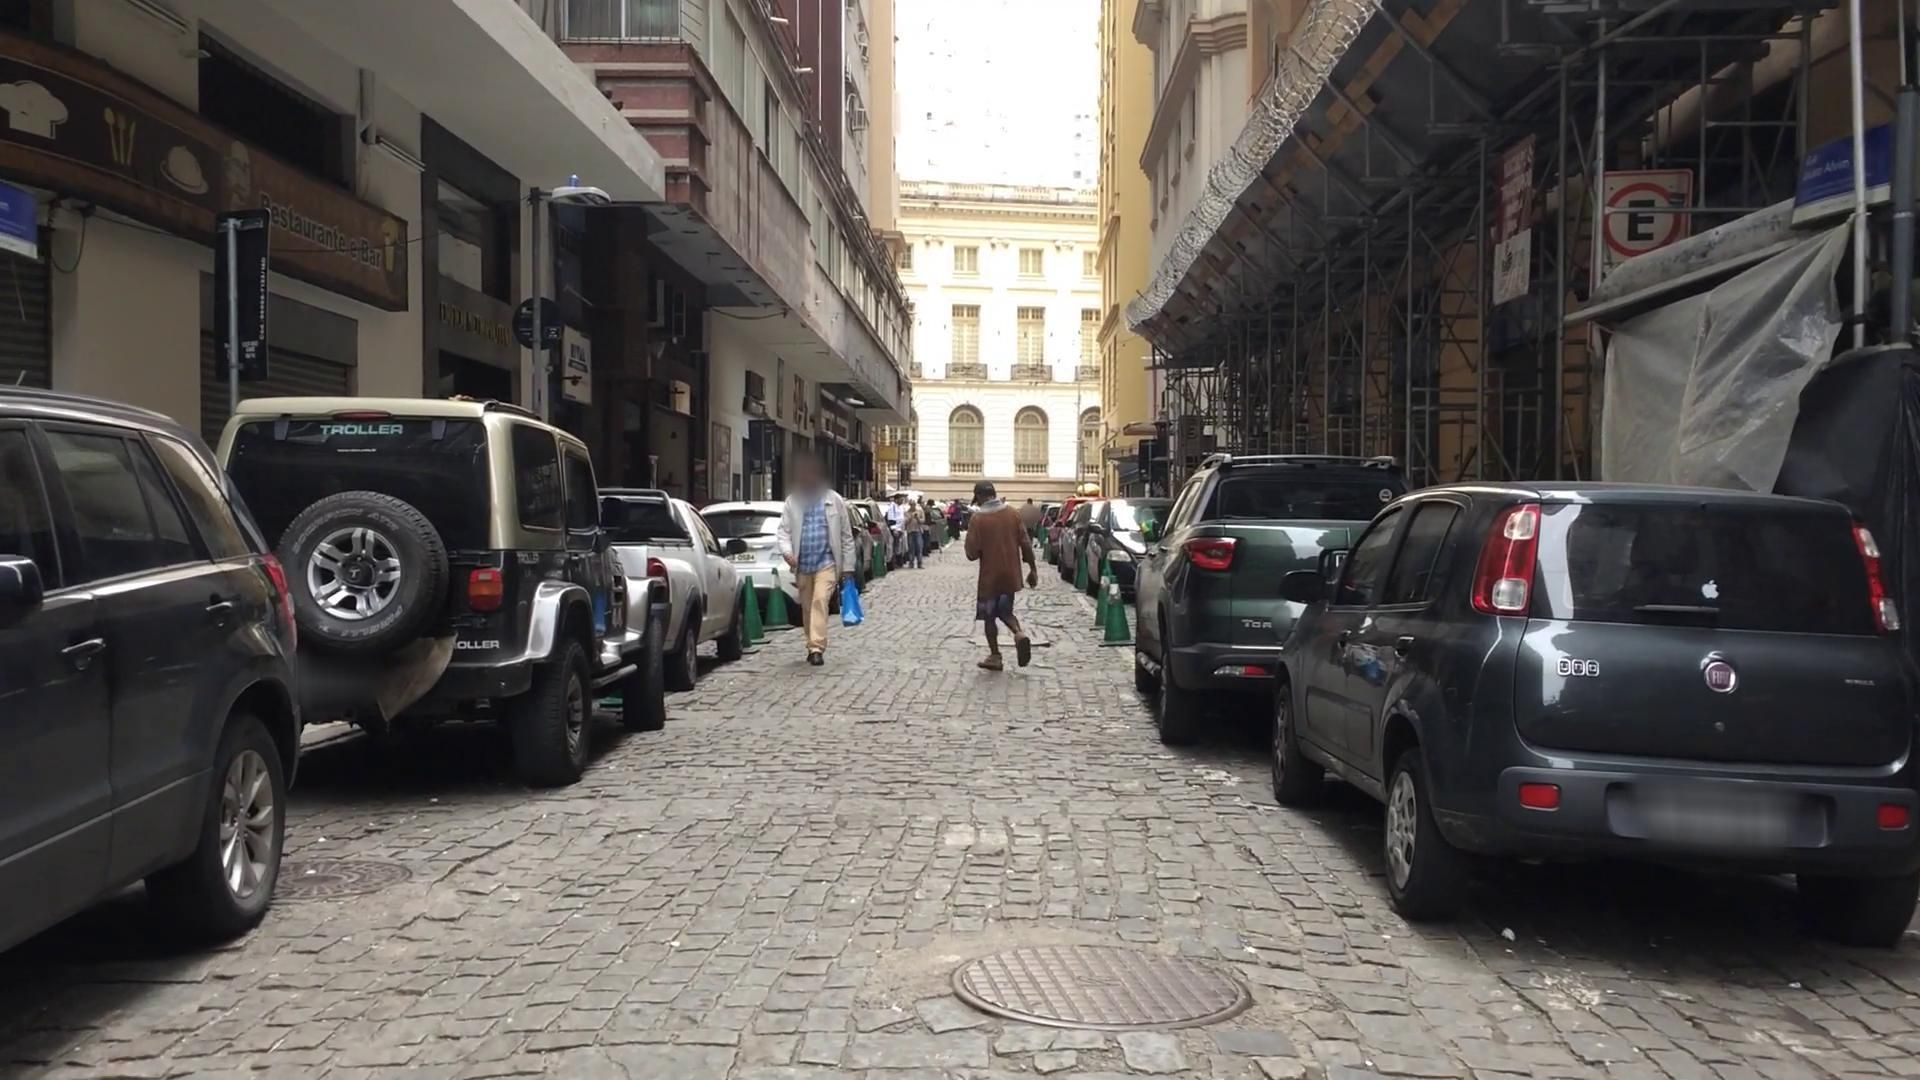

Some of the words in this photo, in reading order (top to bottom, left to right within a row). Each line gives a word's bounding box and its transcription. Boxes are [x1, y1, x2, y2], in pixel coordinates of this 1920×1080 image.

[258, 191, 346, 254] Restaurante
[350, 237, 358, 258] e
[360, 237, 382, 271] Bar
[1627, 200, 1655, 241] E
[319, 423, 404, 435] TROLLER
[457, 640, 500, 649] OLLER
